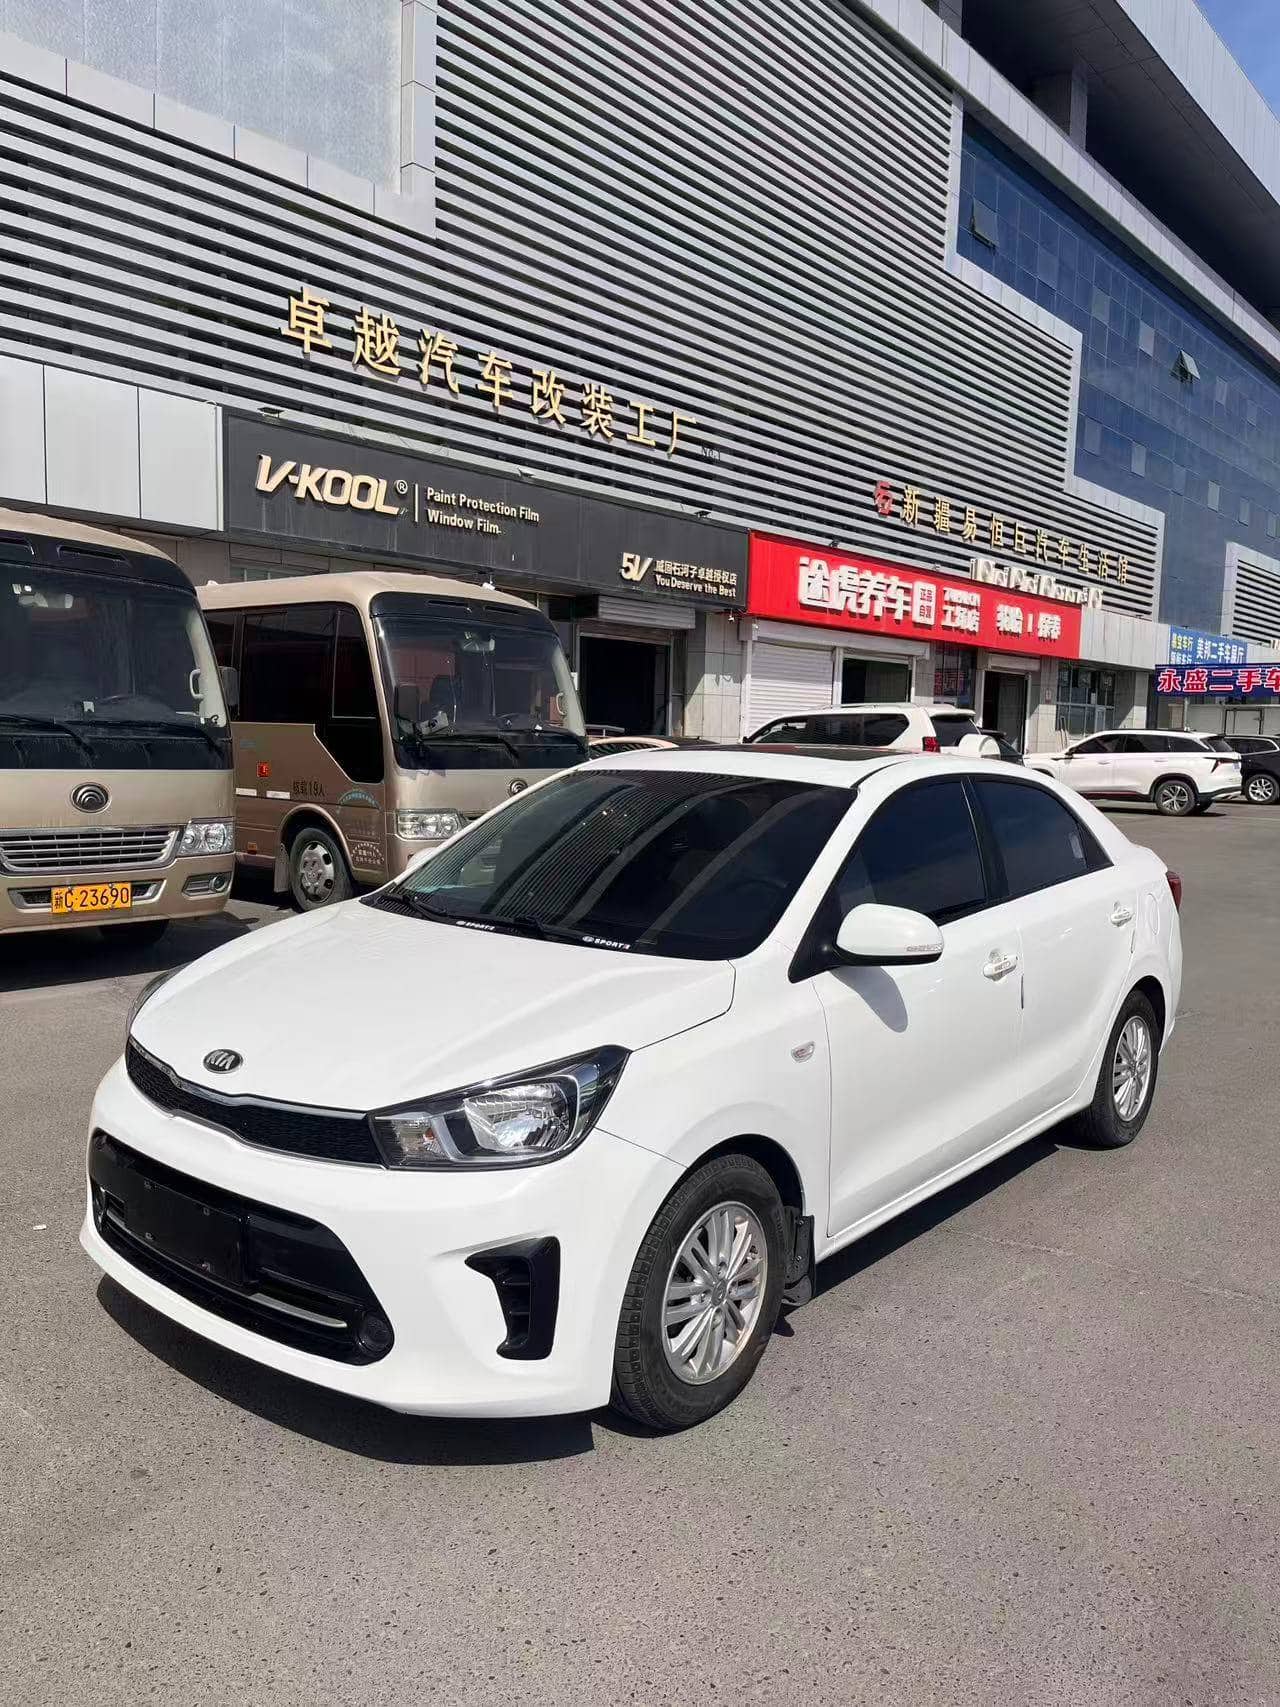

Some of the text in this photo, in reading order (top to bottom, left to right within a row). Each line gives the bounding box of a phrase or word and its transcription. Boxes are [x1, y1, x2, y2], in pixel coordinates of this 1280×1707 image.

[281, 286, 697, 458] 卓越汽车改装工厂
[427, 487, 540, 522] Paint Protection Film
[427, 509, 474, 530] Window
[704, 583, 717, 595] the
[719, 585, 736, 598] Best
[799, 557, 913, 620] 途虎养车
[1158, 668, 1280, 693] 永盛二手车
